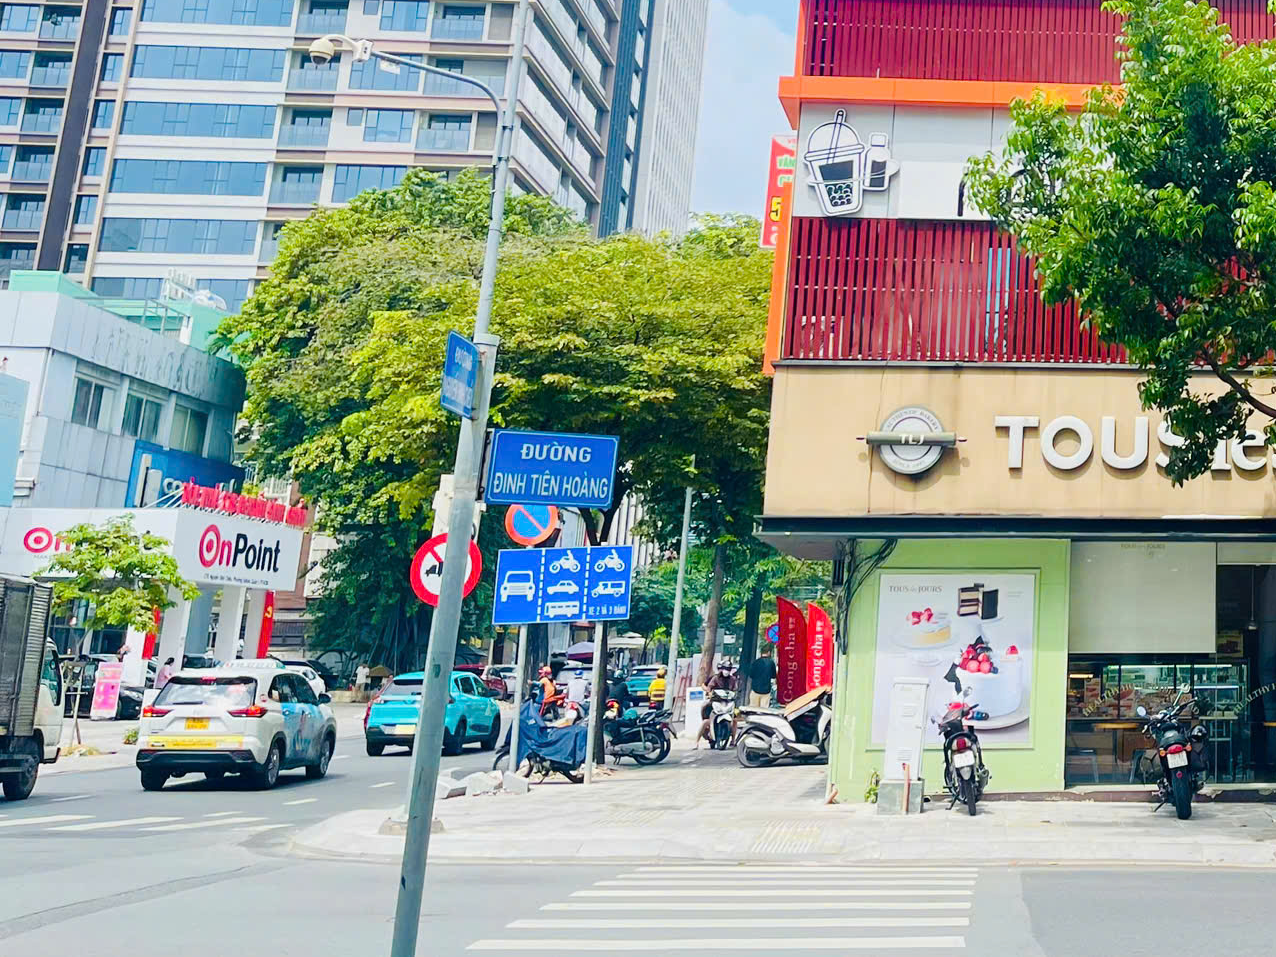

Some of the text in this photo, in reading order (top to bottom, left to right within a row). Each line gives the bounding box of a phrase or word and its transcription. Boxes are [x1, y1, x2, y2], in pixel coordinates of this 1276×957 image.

[520, 441, 592, 463] ĐƯỜNG
[899, 434, 925, 445] TLJ
[493, 470, 608, 499] ĐINH TIÊN HOÀNG
[198, 524, 281, 572] OnPoint
[785, 633, 796, 659] cha
[812, 658, 826, 687] ong
